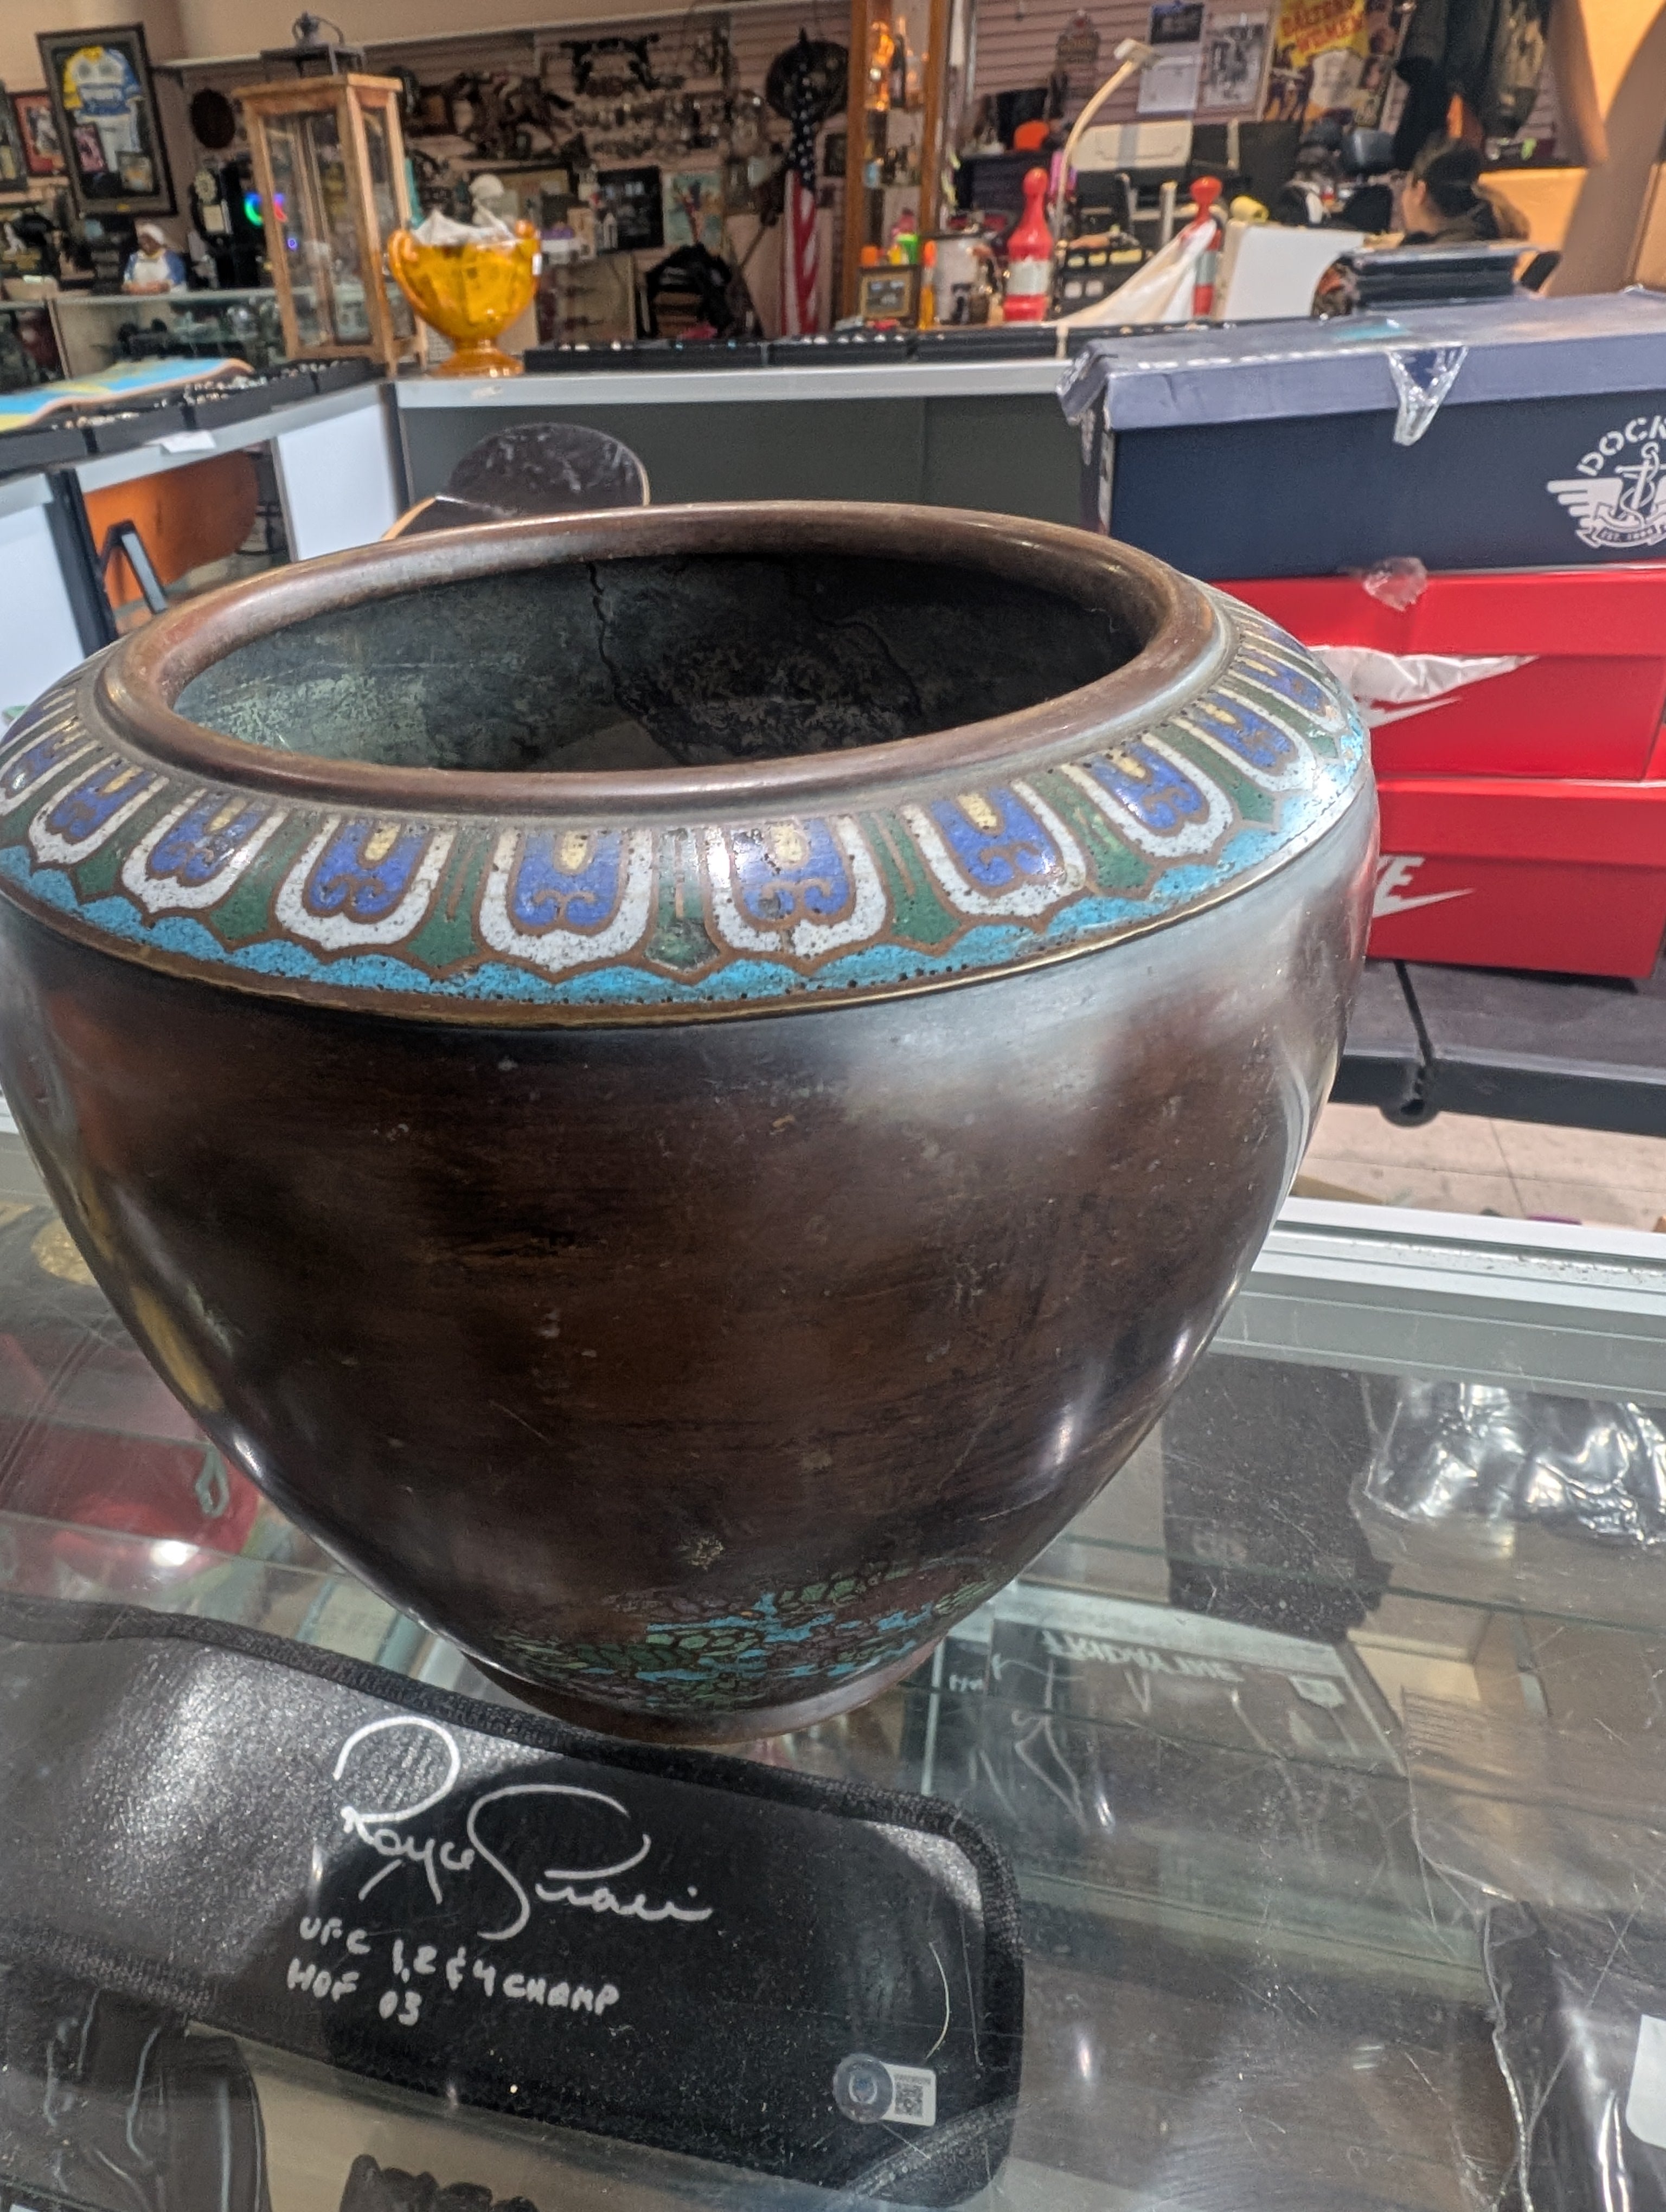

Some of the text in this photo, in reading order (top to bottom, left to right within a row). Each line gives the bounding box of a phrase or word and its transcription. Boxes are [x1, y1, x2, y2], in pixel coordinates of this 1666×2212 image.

[286, 1957, 422, 2026] HOF 03
[299, 1917, 371, 1955] UFC
[502, 1973, 619, 2015] CHAMP
